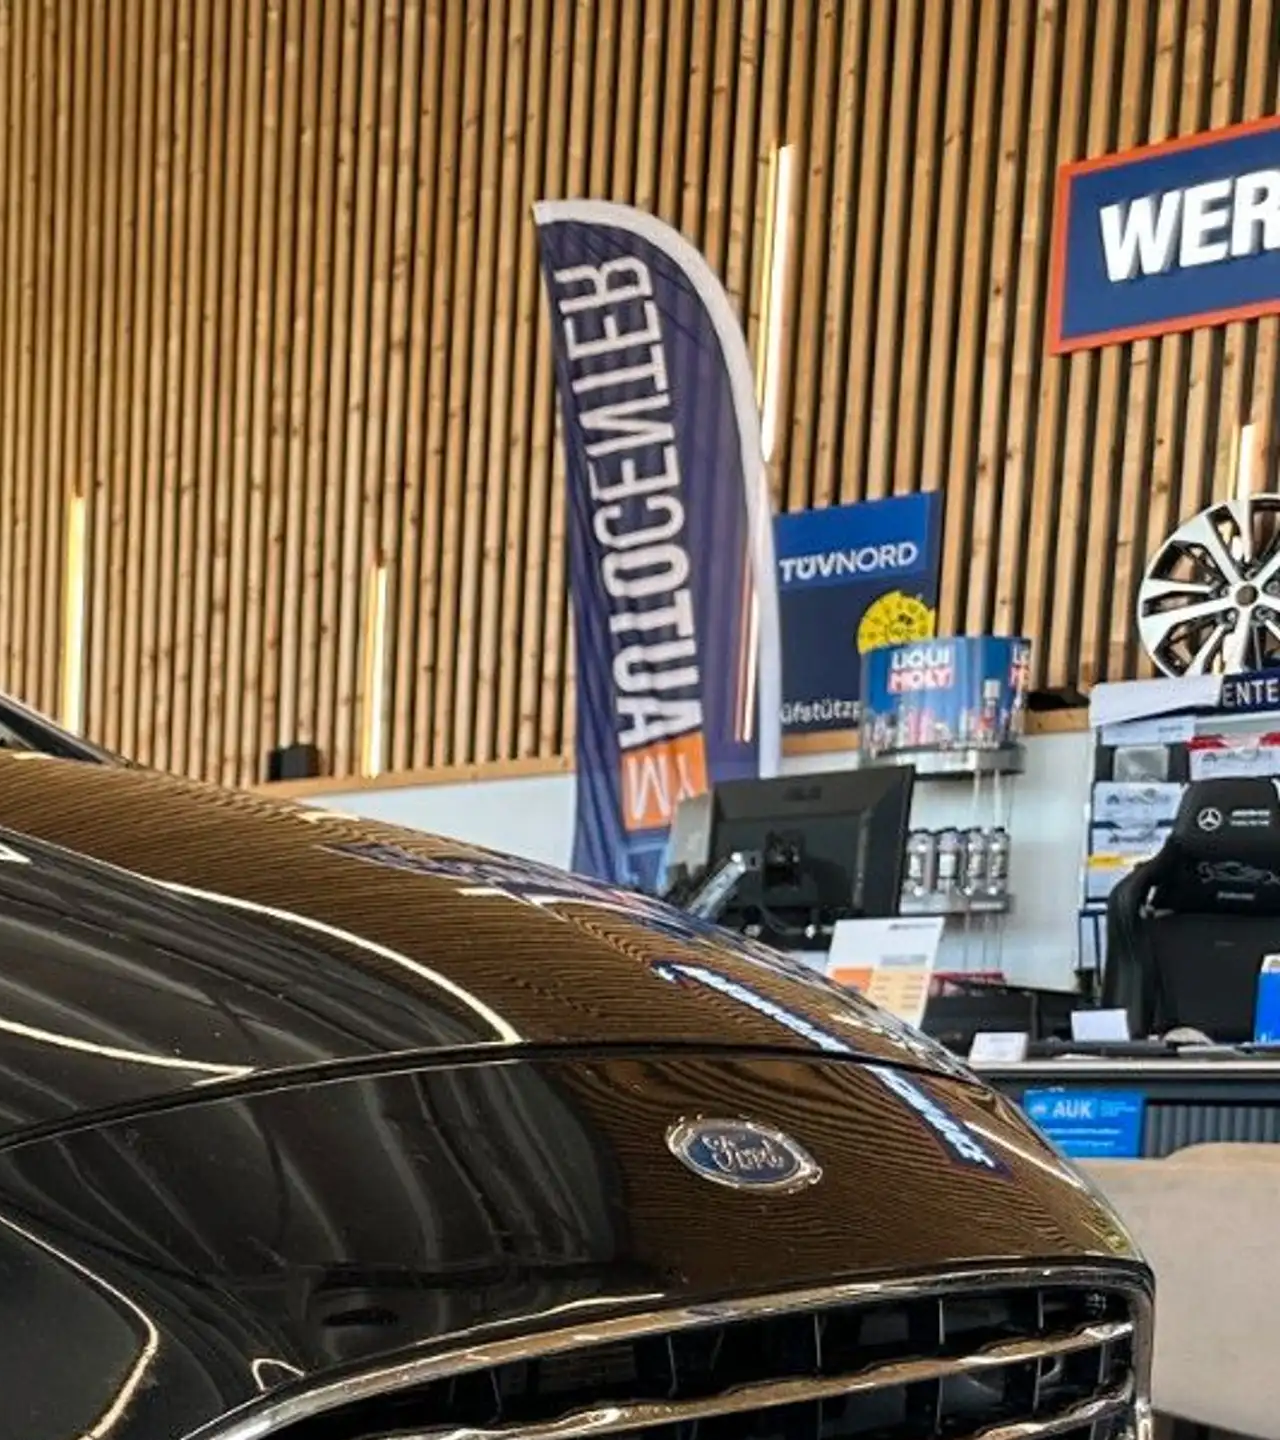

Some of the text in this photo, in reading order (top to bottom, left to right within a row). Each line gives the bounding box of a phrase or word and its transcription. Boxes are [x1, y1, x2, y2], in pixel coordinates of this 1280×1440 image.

[891, 647, 950, 669] LIQUI
[889, 667, 951, 691] MOLY
[1052, 1099, 1093, 1119] AUK
